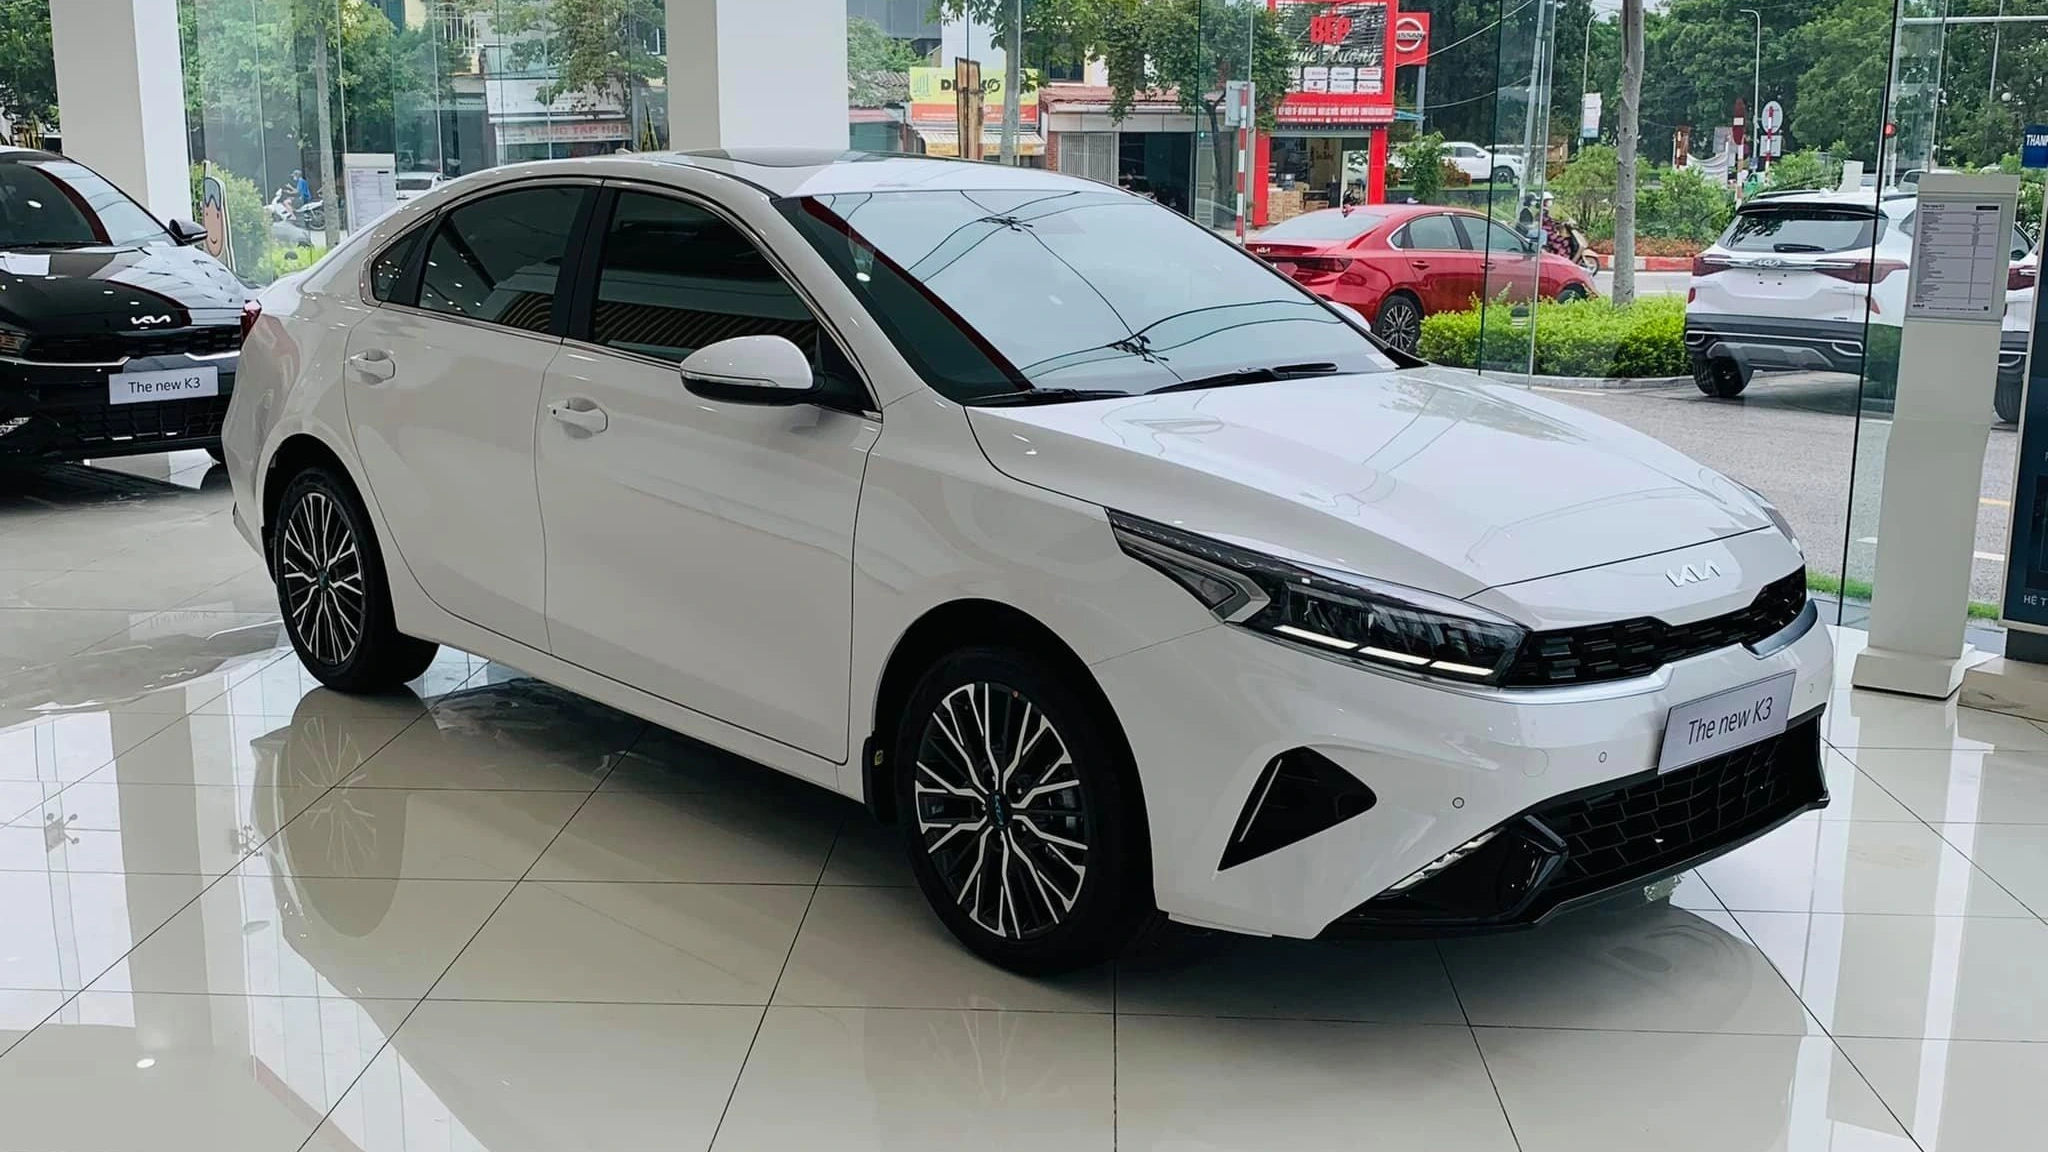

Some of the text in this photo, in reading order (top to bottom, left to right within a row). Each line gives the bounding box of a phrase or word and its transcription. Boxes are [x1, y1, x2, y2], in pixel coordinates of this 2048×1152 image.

[131, 315, 171, 324] KIA
[128, 376, 201, 394] The new K3
[1665, 560, 1720, 587] KIA
[1688, 696, 1773, 745] The new K3
